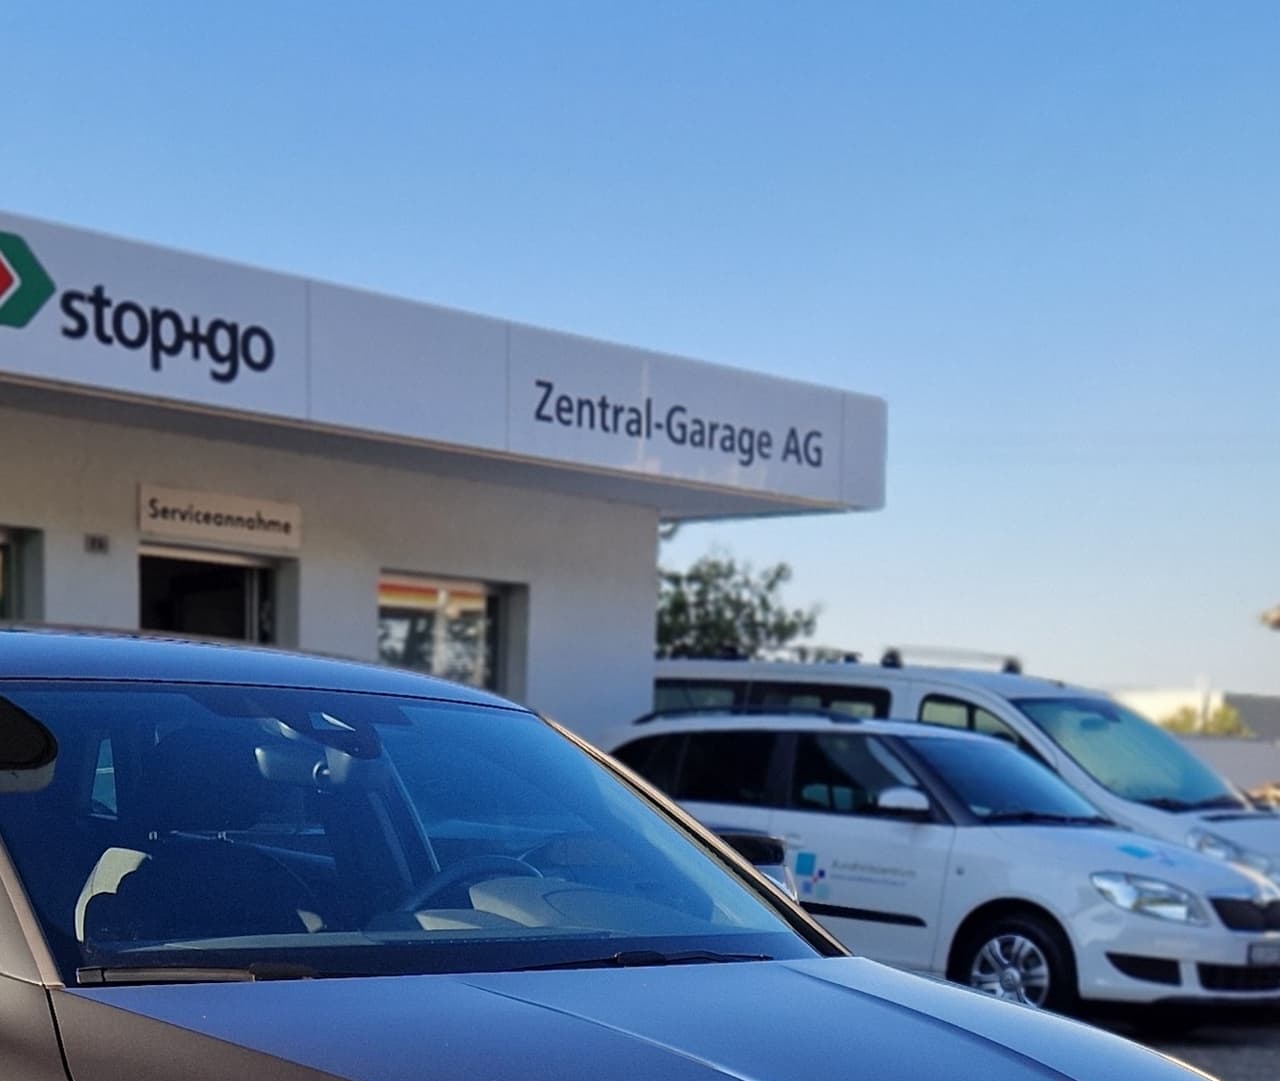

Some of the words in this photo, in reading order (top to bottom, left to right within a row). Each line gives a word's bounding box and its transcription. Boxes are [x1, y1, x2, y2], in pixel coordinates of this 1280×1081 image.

[60, 285, 275, 384] stop+go
[534, 379, 773, 467] Zentral-Garage
[781, 426, 823, 468] AG
[148, 497, 292, 535] Serviceannahme
